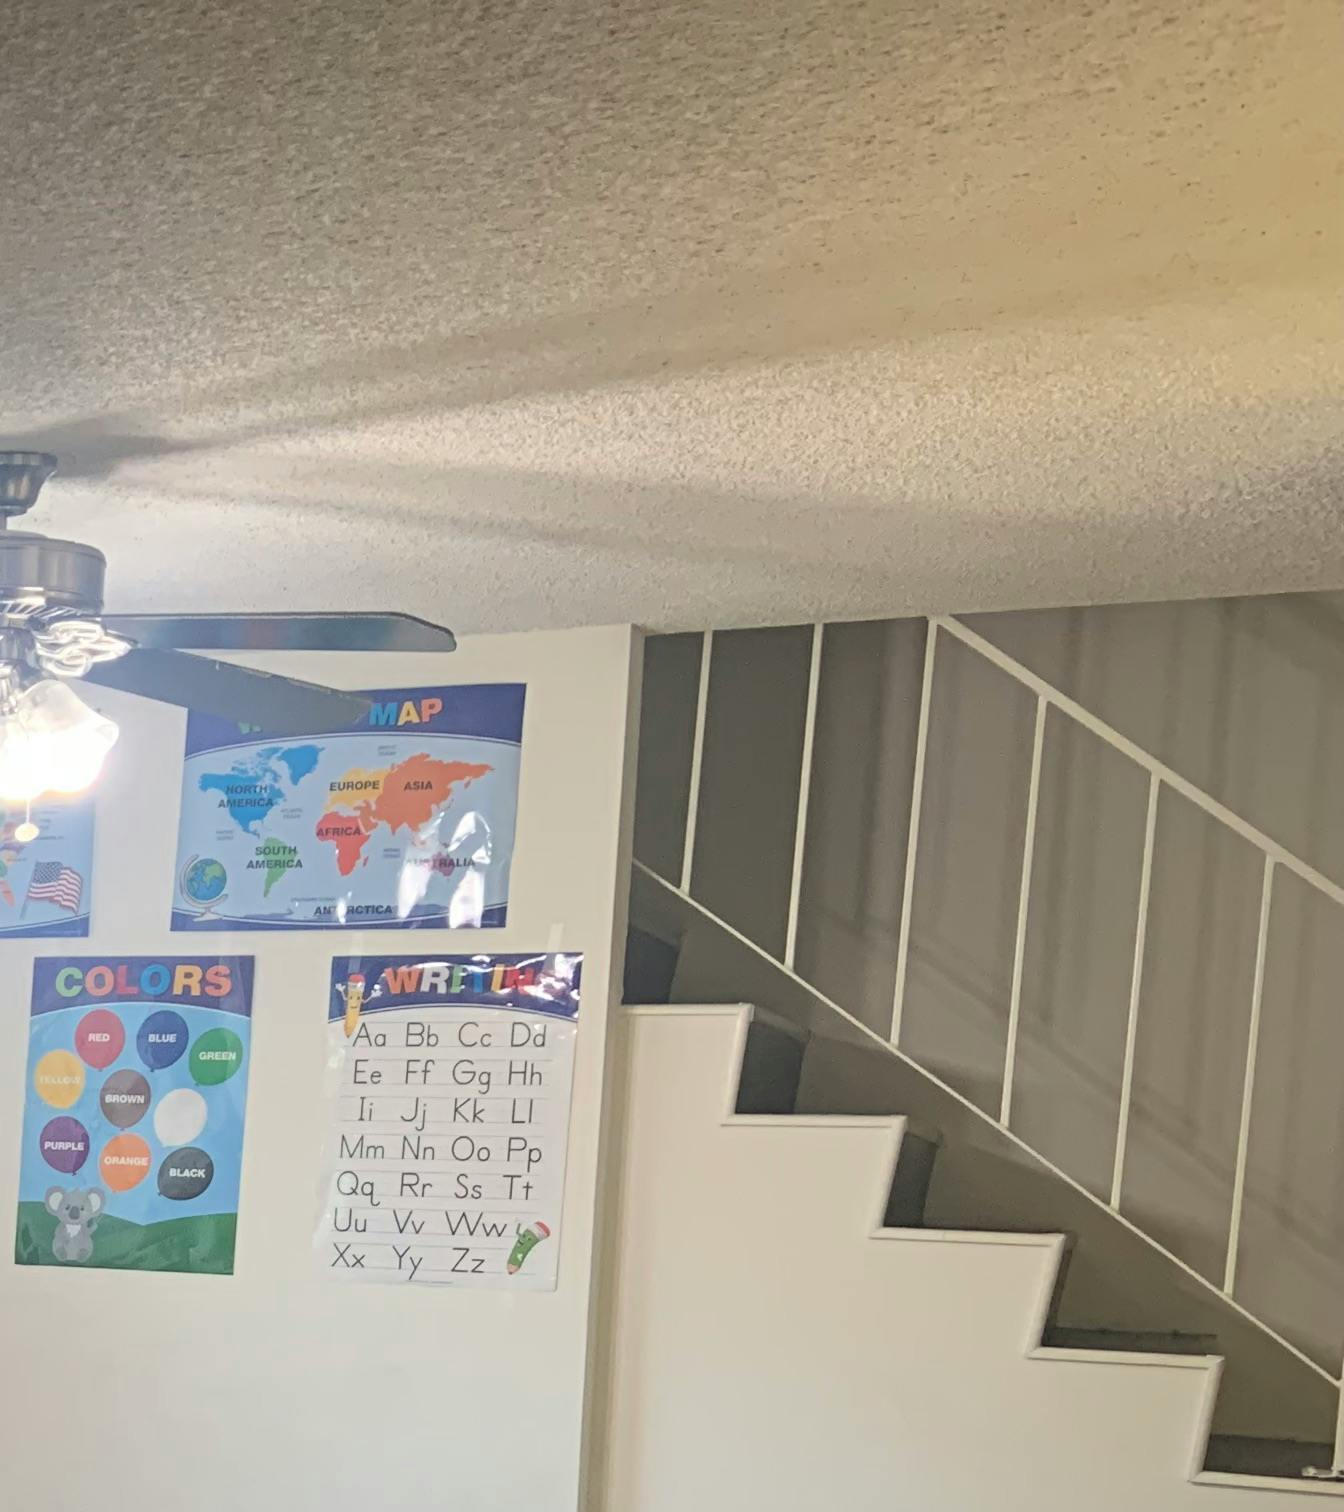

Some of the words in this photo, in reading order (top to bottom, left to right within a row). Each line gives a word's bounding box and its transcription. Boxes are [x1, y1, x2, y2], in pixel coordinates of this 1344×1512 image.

[368, 697, 443, 727] MAP
[226, 784, 269, 794] NORTH
[329, 779, 381, 792] EUROPE
[403, 780, 433, 791] ASIA
[218, 798, 275, 808] AMERICA
[316, 826, 362, 837] AFRICA
[255, 845, 298, 856] SOUTH
[245, 858, 304, 870] AMERICA
[314, 905, 393, 916] ANRCTICA
[55, 963, 233, 998] COLORS
[384, 962, 562, 997] WRITIN
[88, 1033, 110, 1043] RED
[148, 1033, 177, 1043] BLUE
[352, 1022, 387, 1047] Aa
[405, 1022, 439, 1047] Bb
[458, 1022, 492, 1048] Cc
[511, 1022, 547, 1048] Dd
[199, 1051, 236, 1061] GREEN
[40, 1075, 81, 1084] YELLOW
[353, 1060, 382, 1085] Ee
[405, 1059, 435, 1085] Ff
[452, 1059, 491, 1095] Gg
[508, 1060, 543, 1086] Hh
[104, 1094, 145, 1104] BROWN
[357, 1097, 373, 1122] Ii
[400, 1097, 427, 1132] Jj
[452, 1098, 485, 1123] Kk
[511, 1098, 533, 1124] Ll
[44, 1141, 85, 1151] PURPLE
[339, 1134, 385, 1160] Mm
[401, 1135, 435, 1161] Nn
[451, 1135, 491, 1162] Oo
[506, 1137, 542, 1173] Pp
[104, 1156, 149, 1167] ORANGE
[169, 1167, 206, 1179] BLACK
[336, 1171, 381, 1207] Qq
[400, 1172, 433, 1198] Rr
[454, 1173, 483, 1200] Ss
[502, 1174, 533, 1200] Tt
[333, 1207, 367, 1232] Uu
[393, 1209, 425, 1235] Vv
[444, 1210, 507, 1237] Ww
[330, 1243, 365, 1268] Xx
[392, 1245, 423, 1281] Yy
[451, 1247, 485, 1274] Zz
